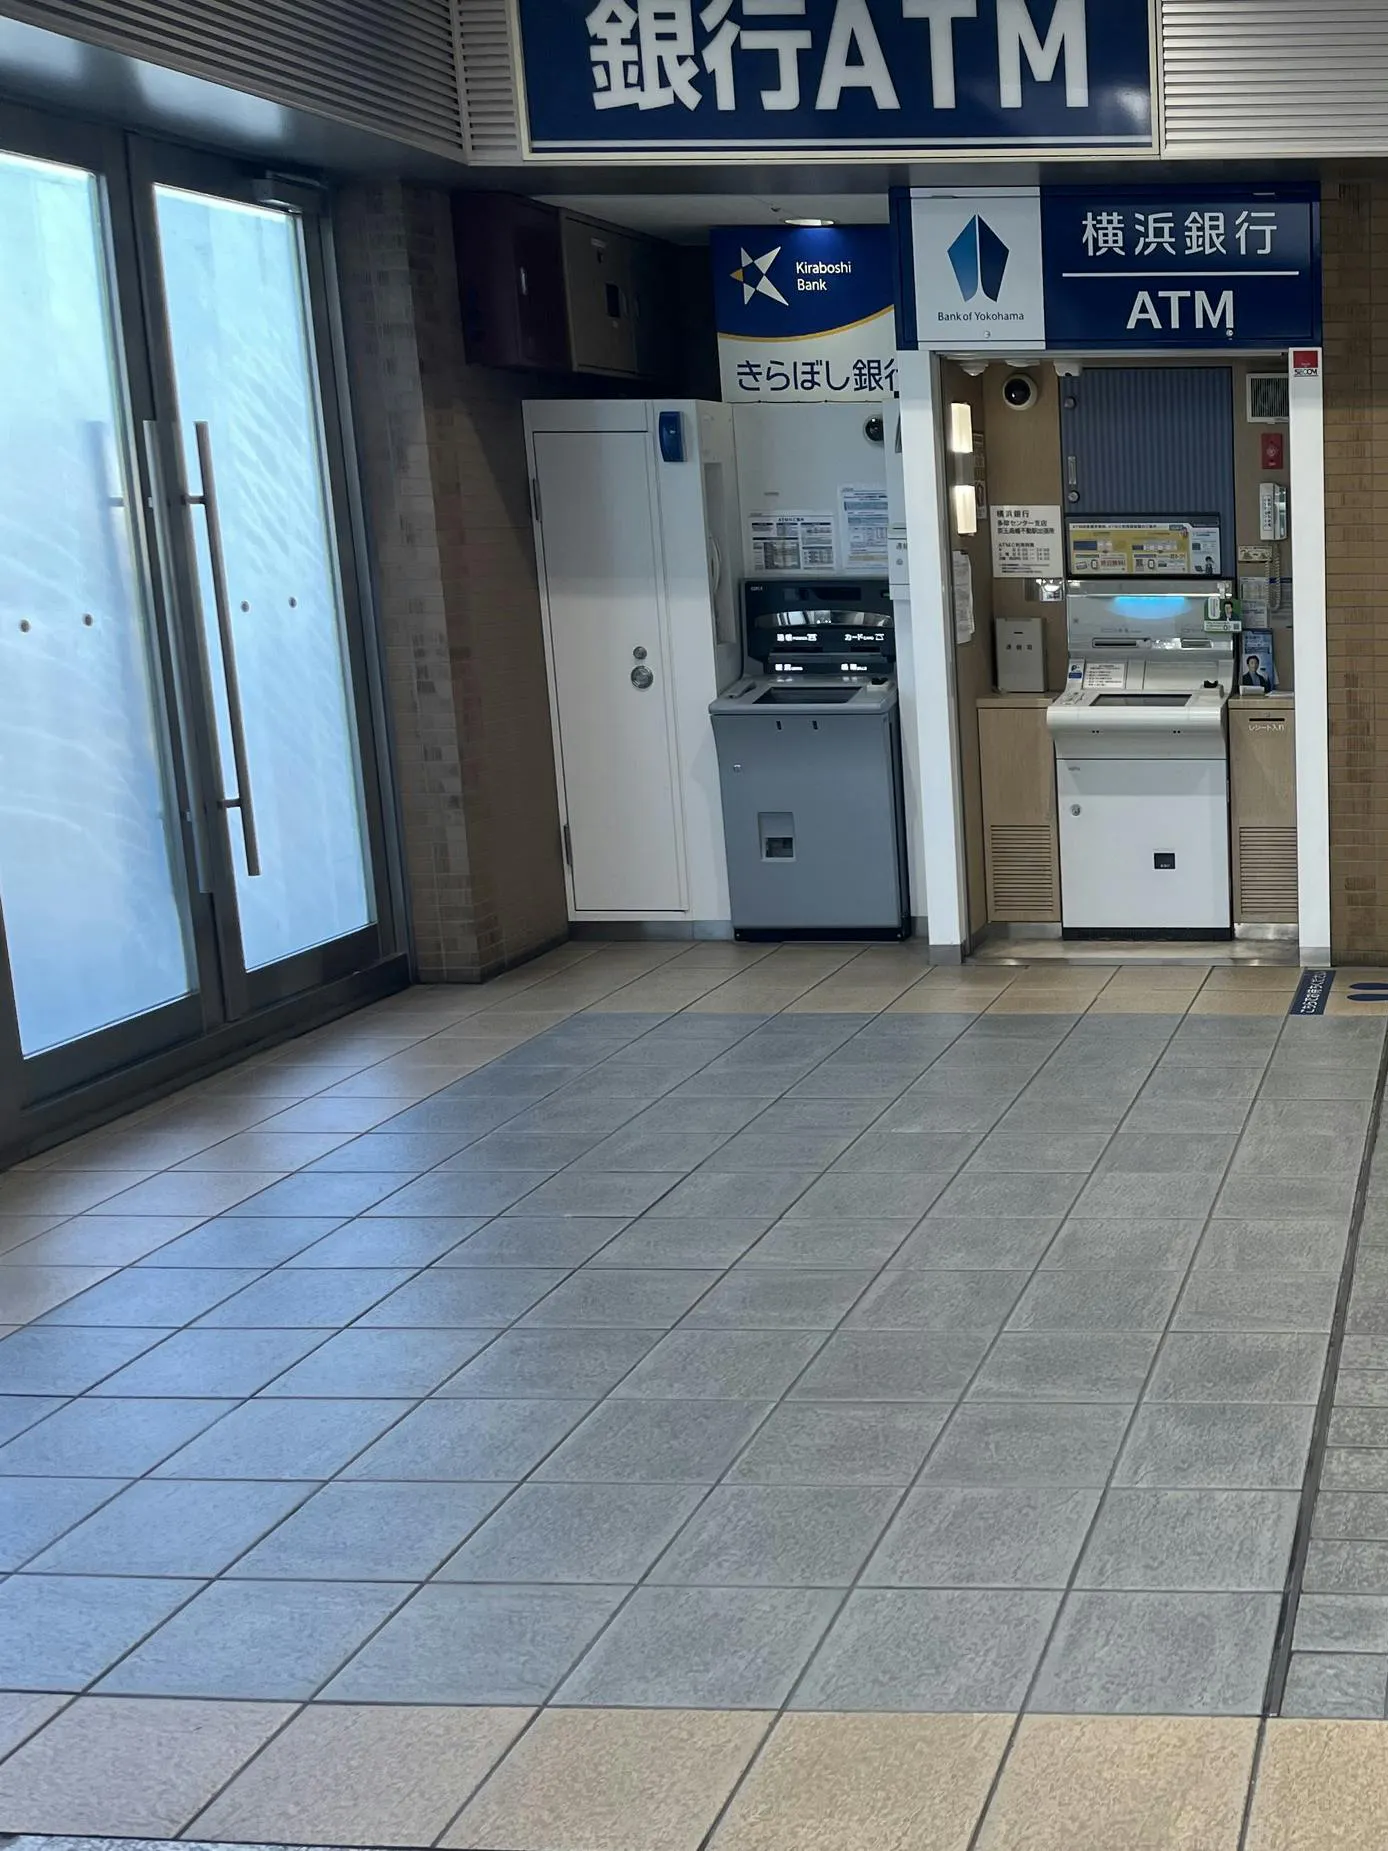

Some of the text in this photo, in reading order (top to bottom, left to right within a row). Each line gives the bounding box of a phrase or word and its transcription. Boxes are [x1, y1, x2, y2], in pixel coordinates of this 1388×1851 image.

[585, 0, 1089, 112] 銀行ATM
[1081, 210, 1277, 257] 横浜銀行
[796, 261, 852, 274] Kiraboshi
[797, 278, 827, 291] Bank
[937, 311, 1025, 322] Bank of Yokohama
[1126, 290, 1234, 330] ATM
